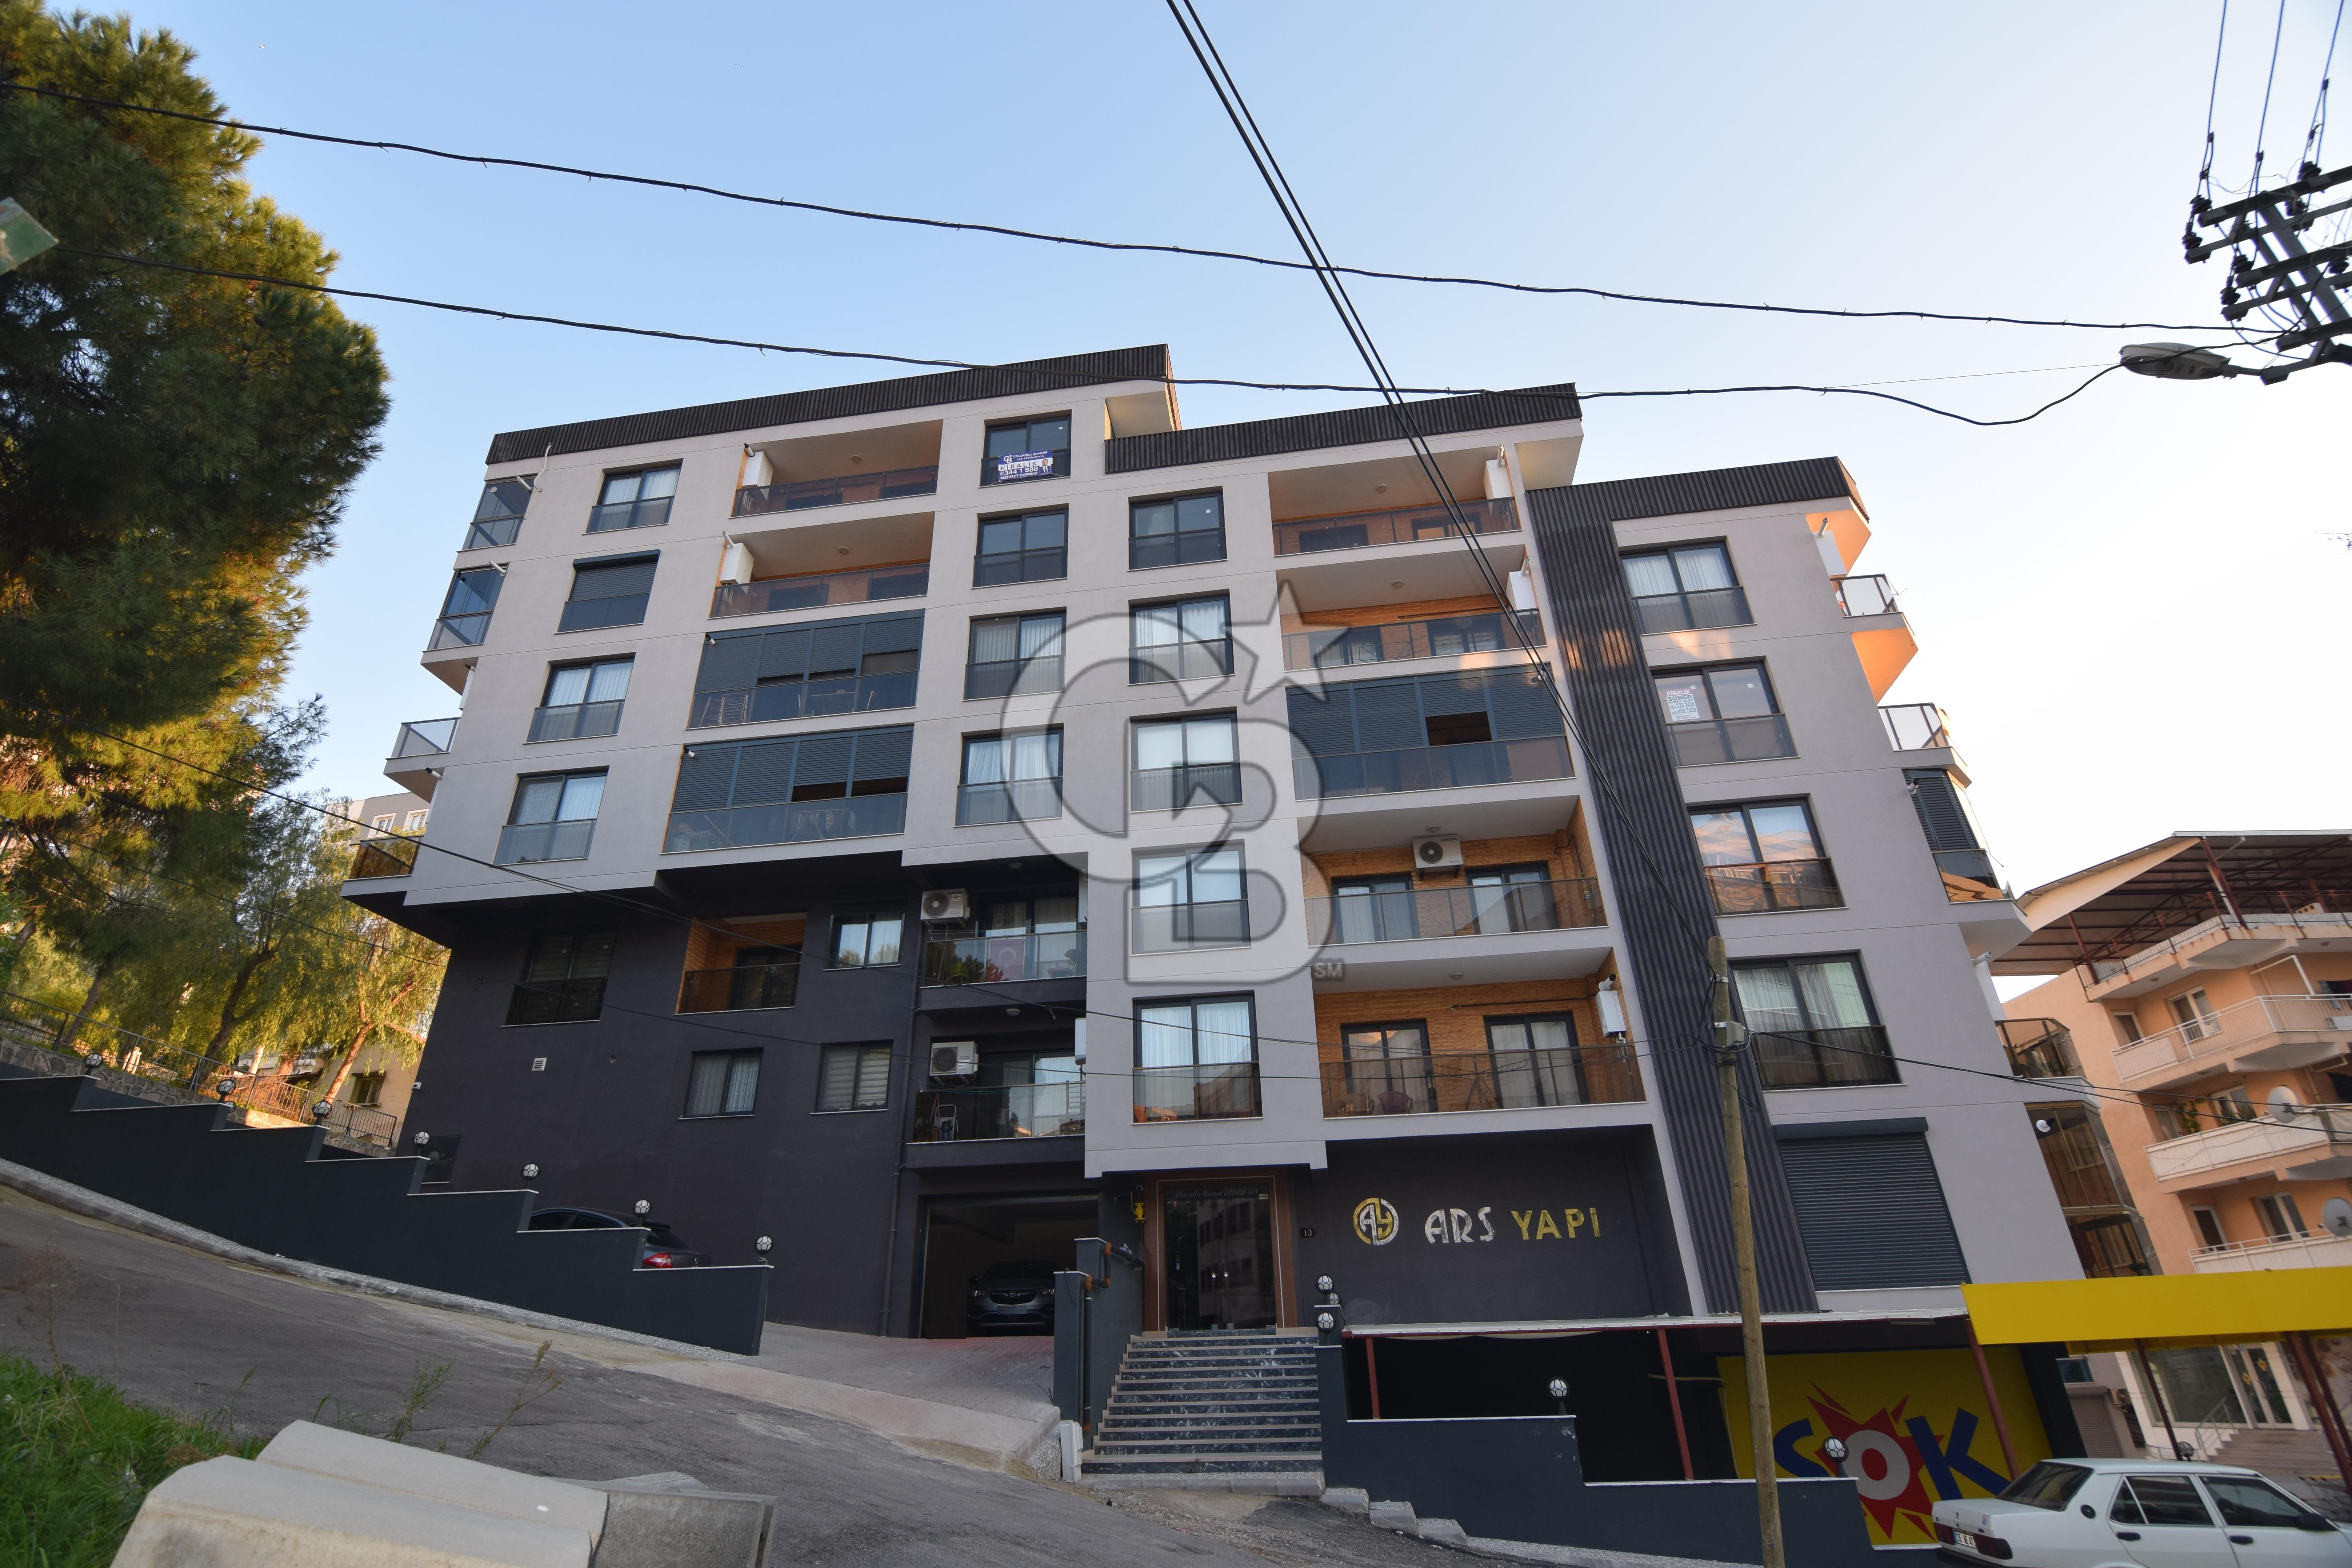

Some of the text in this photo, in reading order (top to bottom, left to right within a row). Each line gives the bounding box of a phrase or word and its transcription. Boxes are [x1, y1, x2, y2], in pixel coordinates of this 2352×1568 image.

[1000, 461, 1038, 470] KİRALIK
[1425, 1207, 1601, 1245] ARS YAPI
